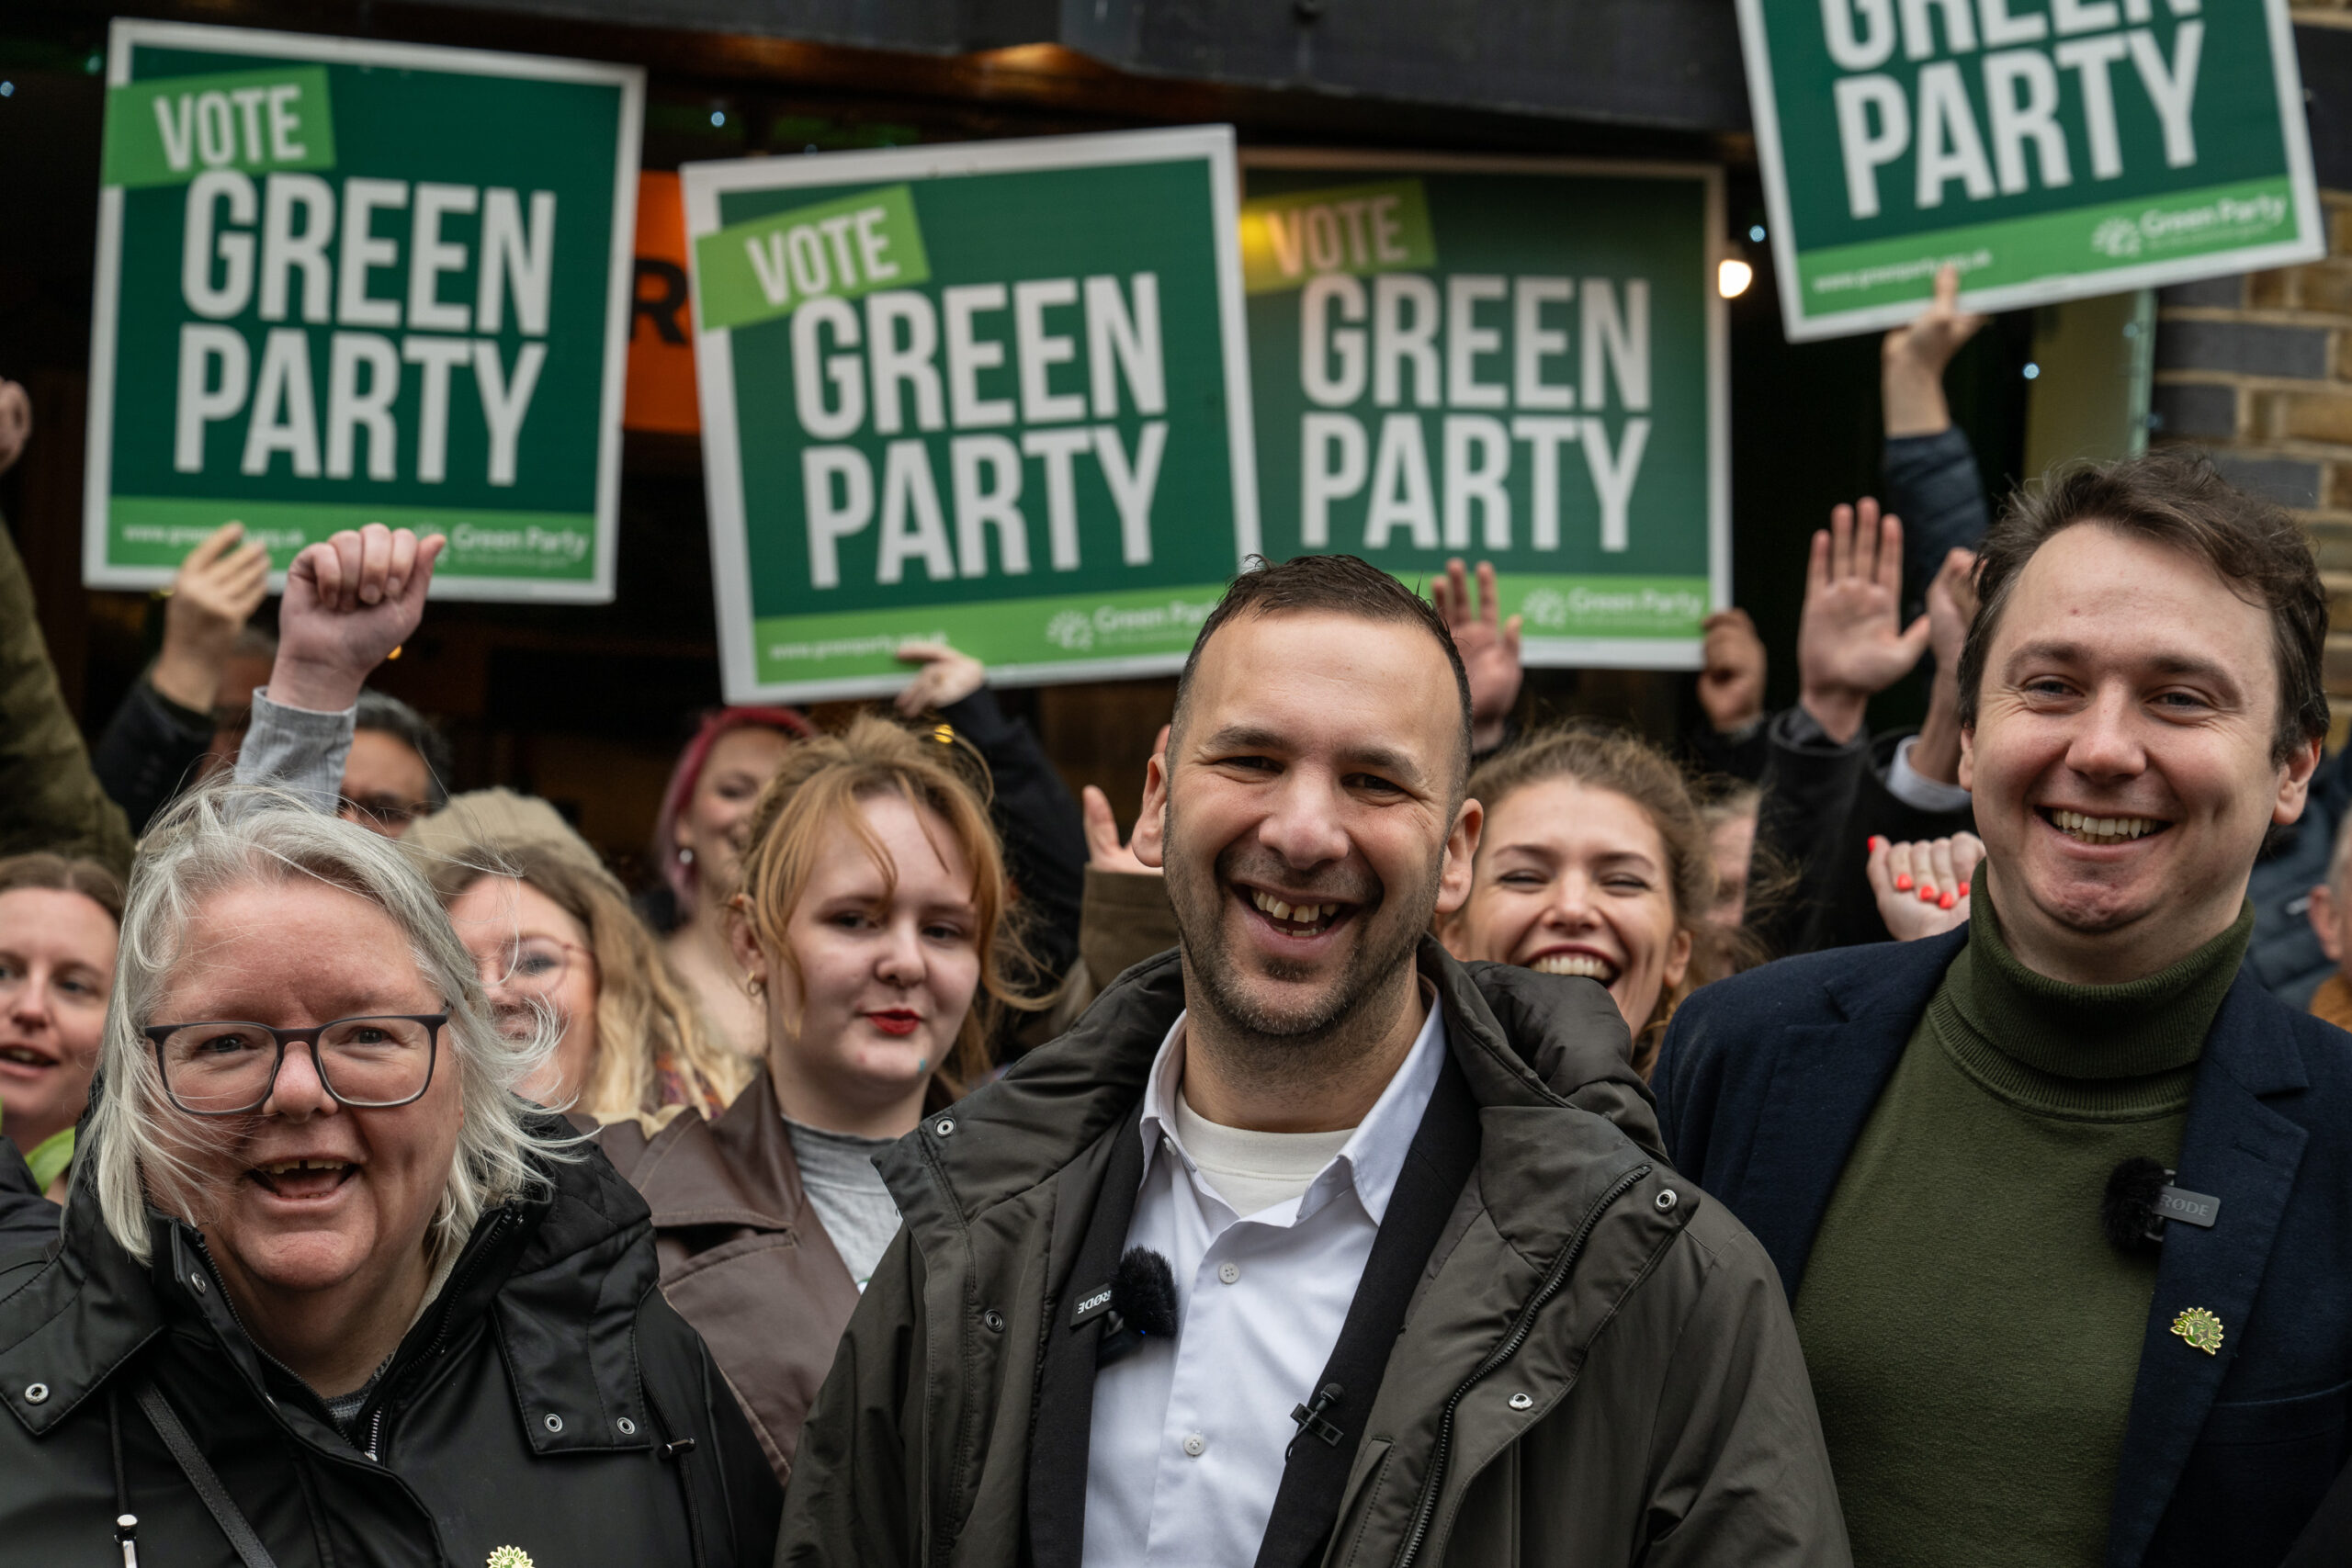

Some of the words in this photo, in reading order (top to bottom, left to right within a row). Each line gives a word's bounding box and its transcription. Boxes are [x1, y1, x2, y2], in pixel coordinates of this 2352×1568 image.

[153, 85, 306, 172] VOTE
[1833, 18, 2205, 220] PARTY
[181, 168, 557, 336] GREEN
[745, 208, 899, 305] VOTE
[1268, 194, 1409, 276] VOTE
[175, 322, 548, 487] PARTY
[789, 272, 1167, 440] GREEN
[1300, 273, 1651, 412] GREEN
[801, 421, 1169, 590] PARTY
[1301, 412, 1652, 551] PARTY
